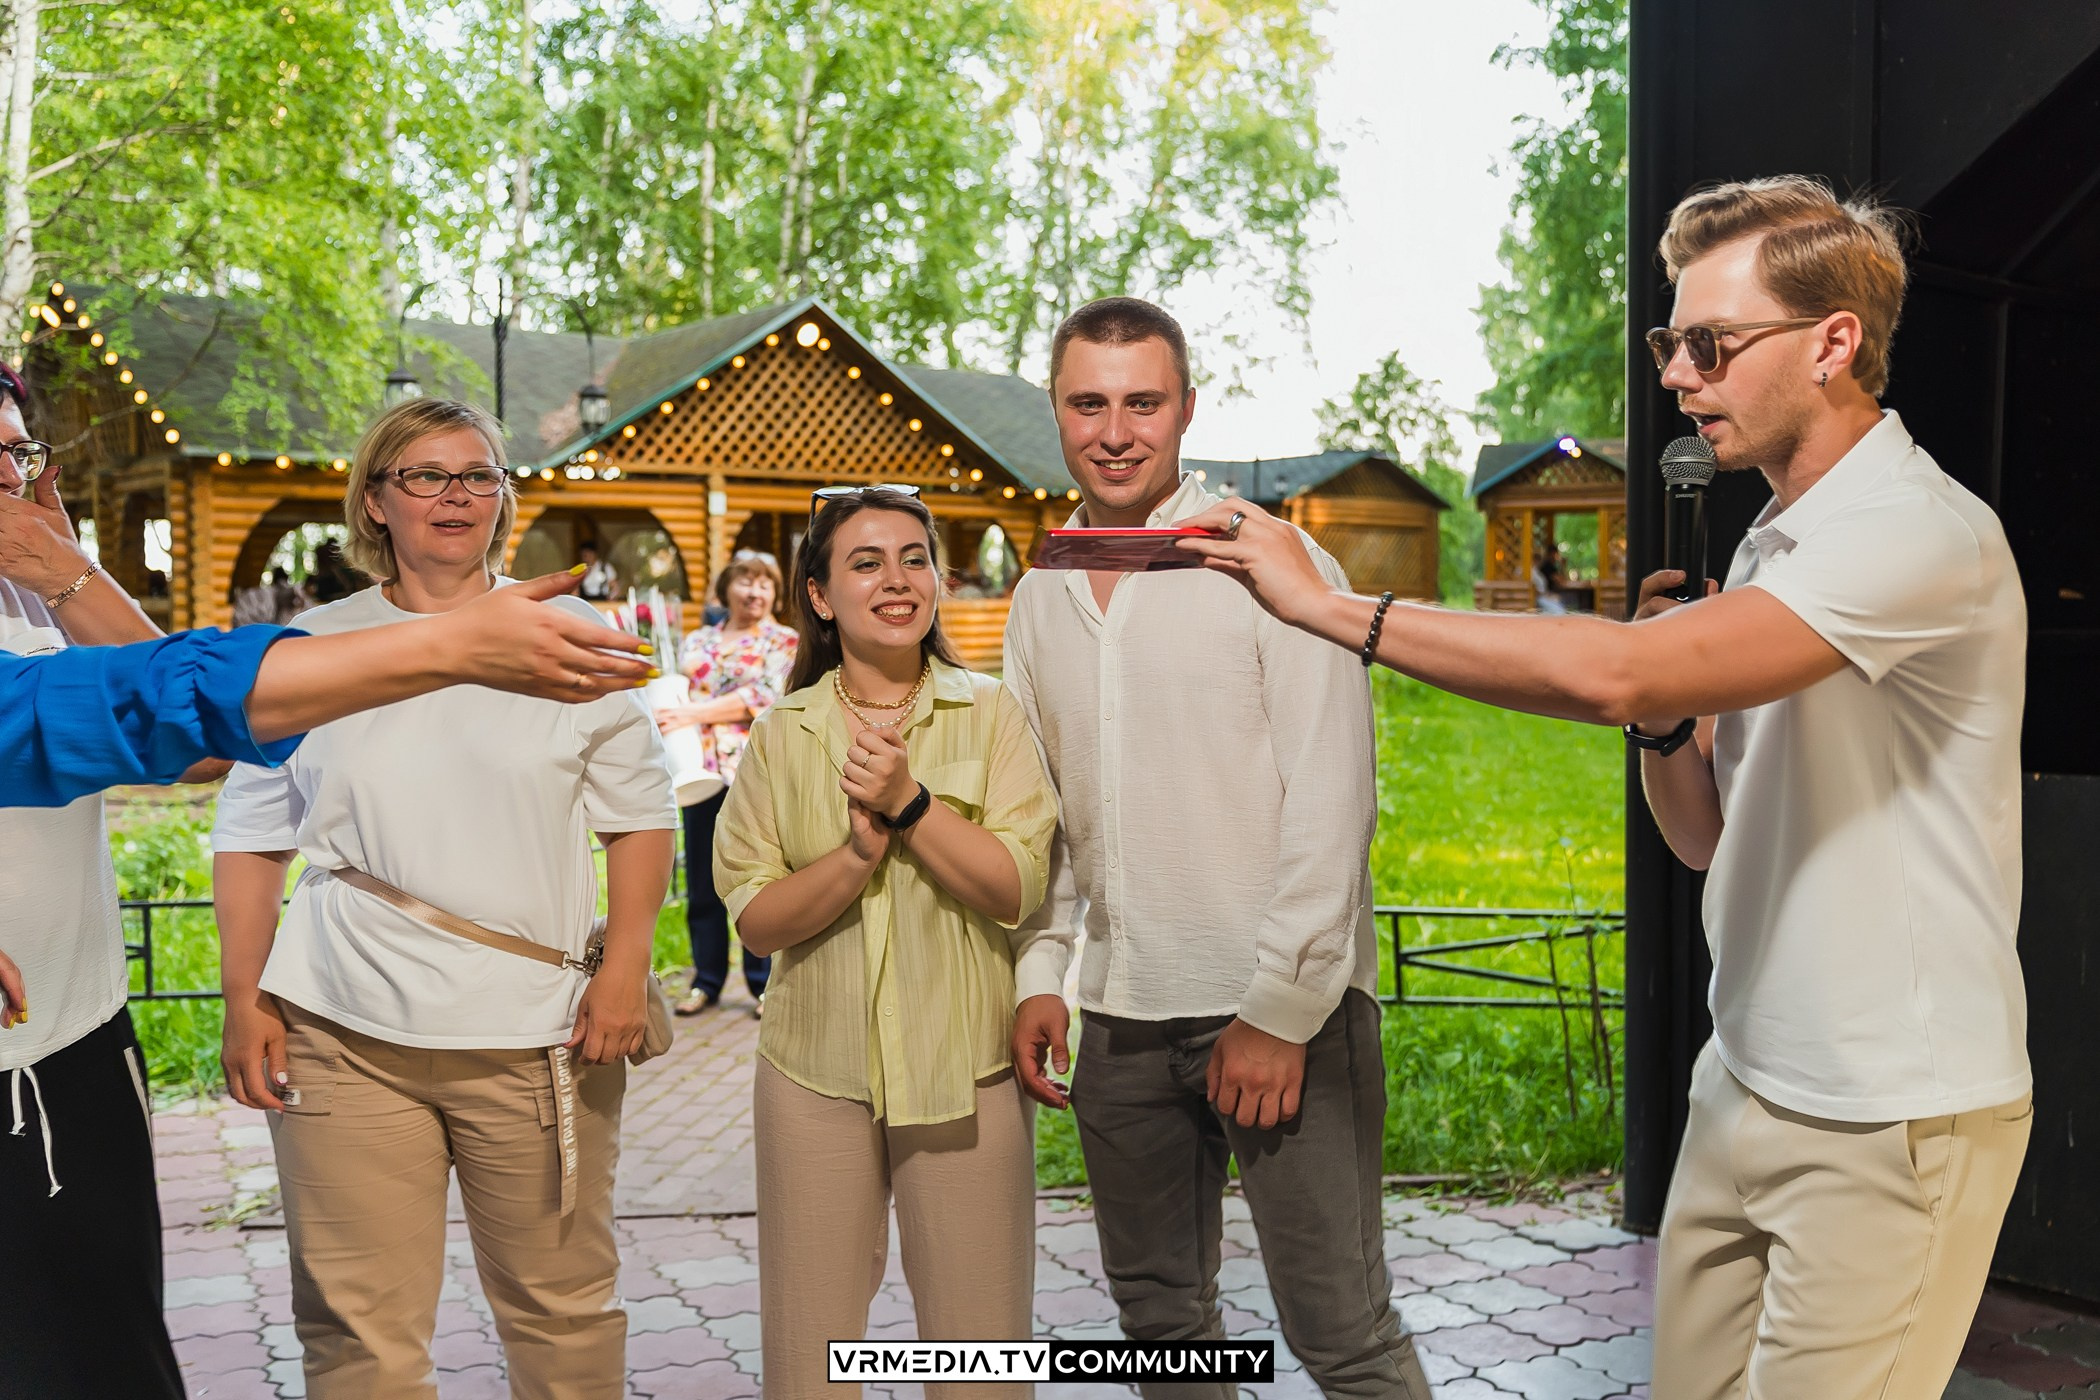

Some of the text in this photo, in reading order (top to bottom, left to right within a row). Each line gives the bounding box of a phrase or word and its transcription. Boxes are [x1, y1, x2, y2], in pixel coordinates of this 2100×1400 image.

[561, 1093, 573, 1115] ME
[563, 1115, 575, 1146] TOLD
[566, 1148, 577, 1176] THEY
